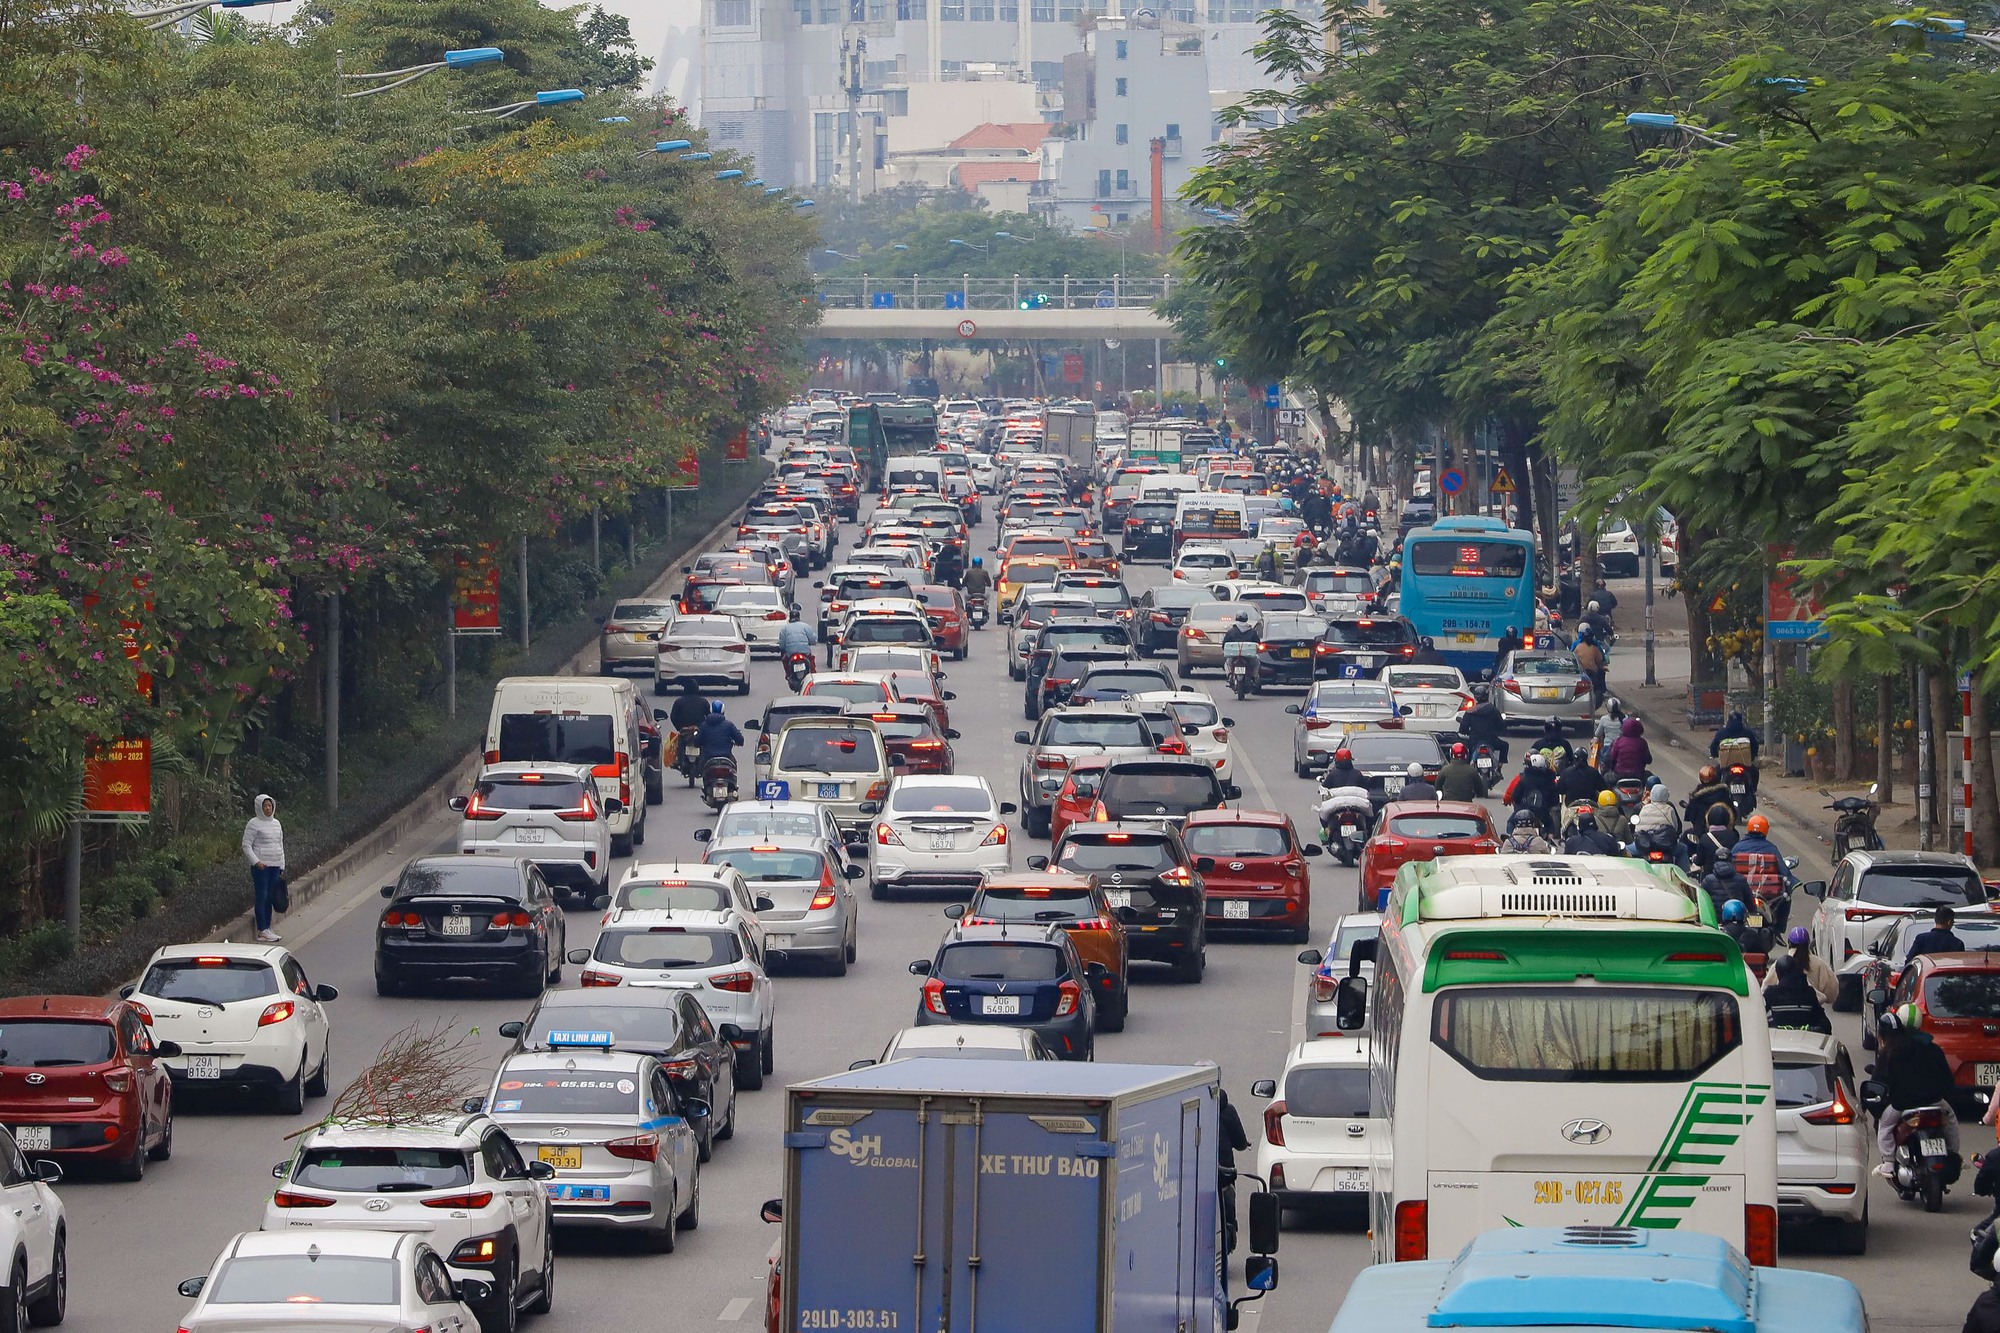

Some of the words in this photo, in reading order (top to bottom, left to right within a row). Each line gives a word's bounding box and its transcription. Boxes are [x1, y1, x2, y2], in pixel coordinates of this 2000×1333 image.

[553, 1032, 571, 1043] TAXI
[571, 1032, 592, 1043] LINH
[592, 1032, 608, 1043] ANH
[195, 1057, 213, 1068] 29A
[188, 1068, 220, 1079] 815.23
[25, 1127, 43, 1138] 30F
[870, 1157, 919, 1169] GLOBAL
[980, 1154, 1007, 1174] XE
[1011, 1154, 1054, 1176] THƯ
[1533, 1181, 1563, 1204] 29B
[1574, 1181, 1624, 1204] 027.65
[801, 1308, 898, 1329] 29LD-303.51
